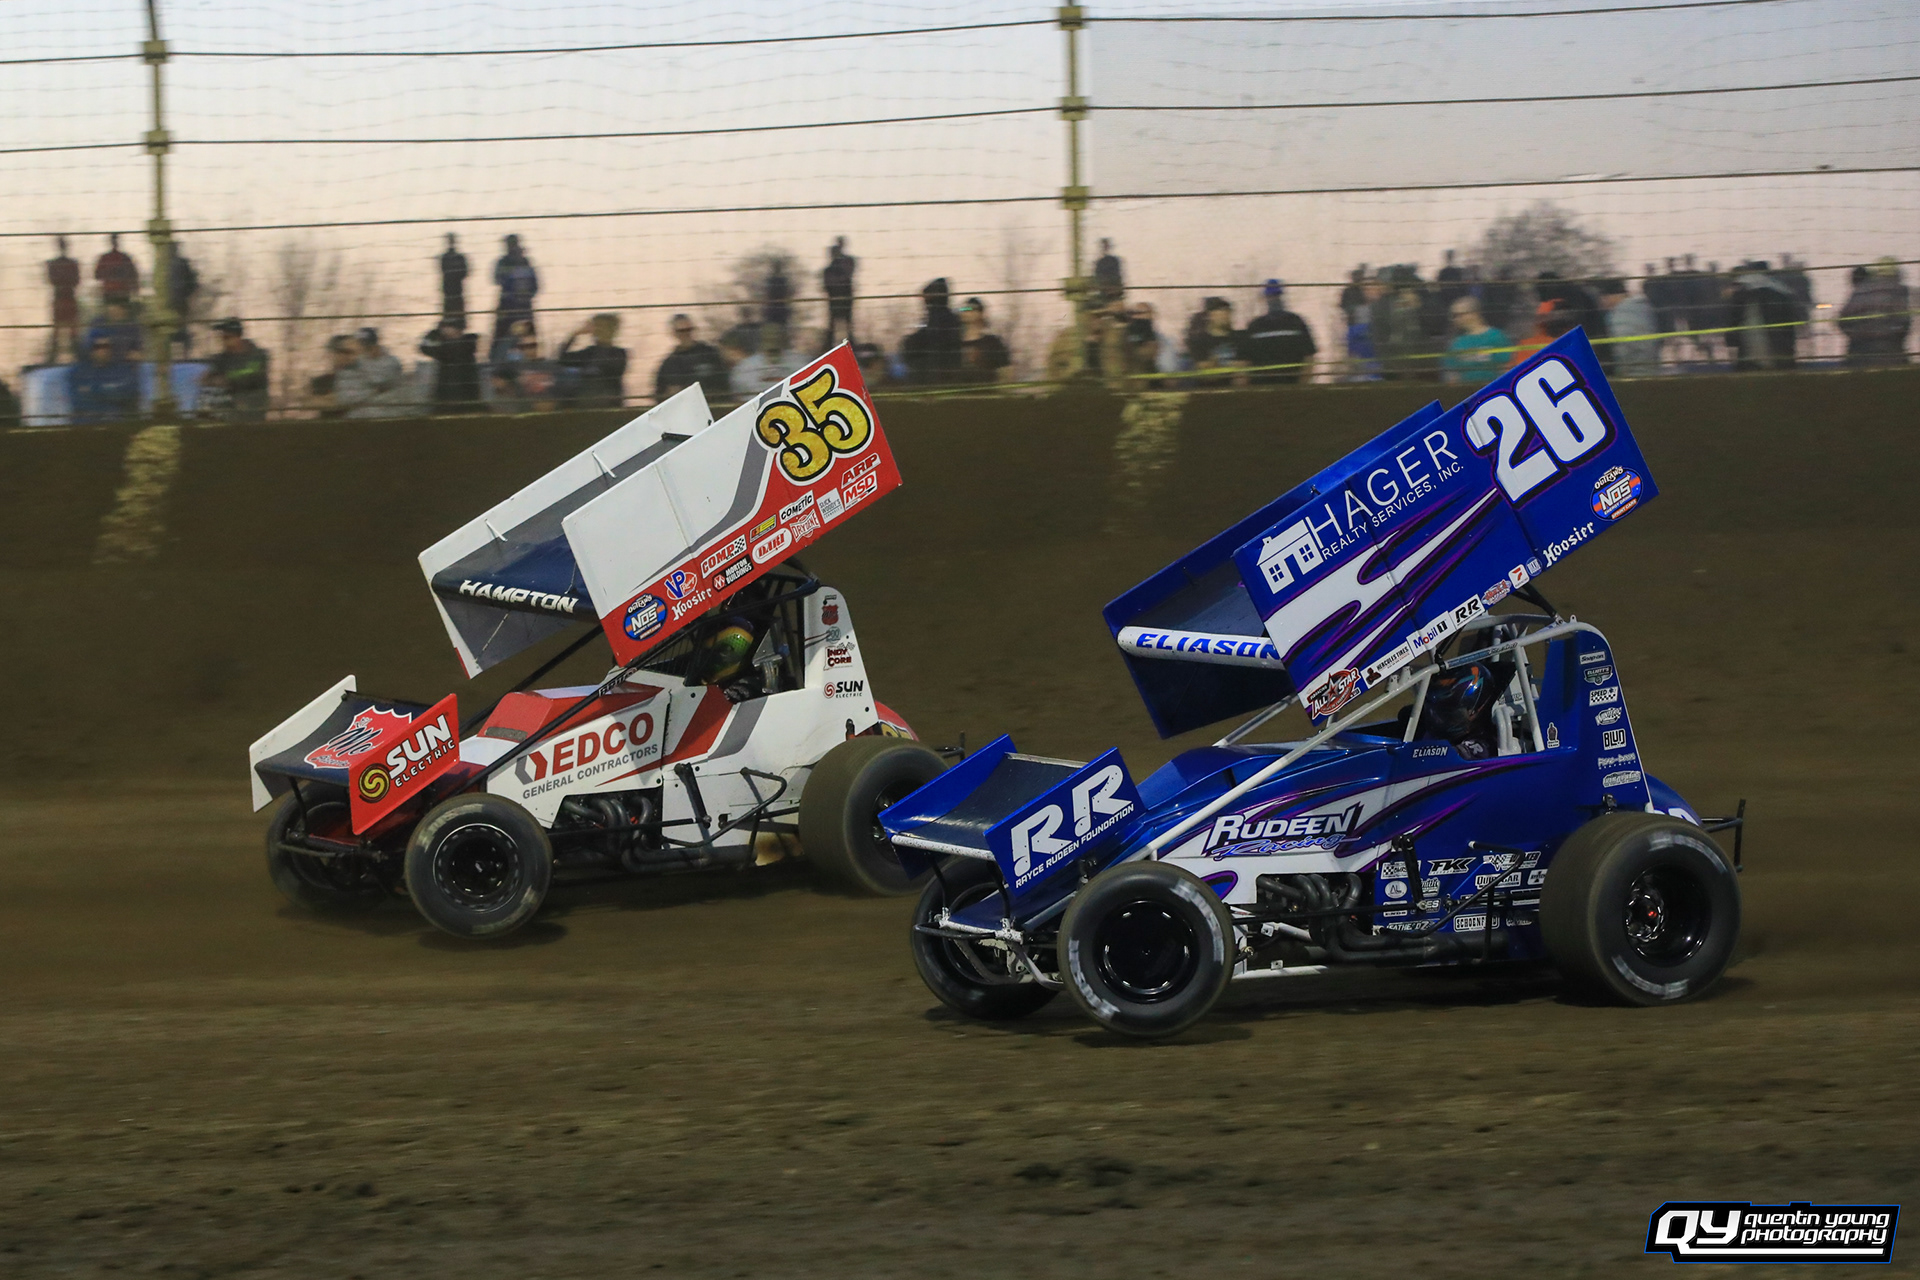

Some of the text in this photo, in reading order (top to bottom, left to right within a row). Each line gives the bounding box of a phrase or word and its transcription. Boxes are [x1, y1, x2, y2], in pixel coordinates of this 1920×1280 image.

[756, 367, 872, 483] 35
[1465, 358, 1607, 500] 26
[843, 454, 877, 486] ARP
[845, 475, 875, 504] MSD
[1305, 430, 1458, 549] HAGER
[1599, 474, 1632, 511] NOS
[781, 495, 812, 520] COMETIC
[1321, 461, 1464, 560] REALTY SERVICES, INC.
[701, 543, 735, 574] COMP
[1543, 522, 1594, 568] Hoosier
[725, 558, 748, 576] MORTON
[459, 579, 579, 614] HAMPTON
[664, 570, 686, 599] VP
[631, 601, 658, 632] NOS
[1455, 598, 1480, 623] RR
[1136, 633, 1281, 661] ELIASON
[1413, 620, 1448, 649] Mobil 1
[827, 648, 848, 658] INDY
[827, 656, 852, 667] CORE
[836, 680, 863, 694] SUN
[1591, 689, 1607, 698] SPEED
[1314, 695, 1329, 714] ALL
[386, 714, 452, 780] SUN
[552, 712, 654, 776] EDCO
[1412, 746, 1448, 759] ELIASON
[394, 739, 456, 788] ELECTRIC
[522, 743, 658, 799] GENERAL CONTRACTORS
[1011, 764, 1133, 877] RR
[1208, 801, 1361, 850] RUDEEN
[1015, 803, 1135, 889] RAYCE RUDEEN FOUNDATION
[1211, 834, 1361, 861] Racing
